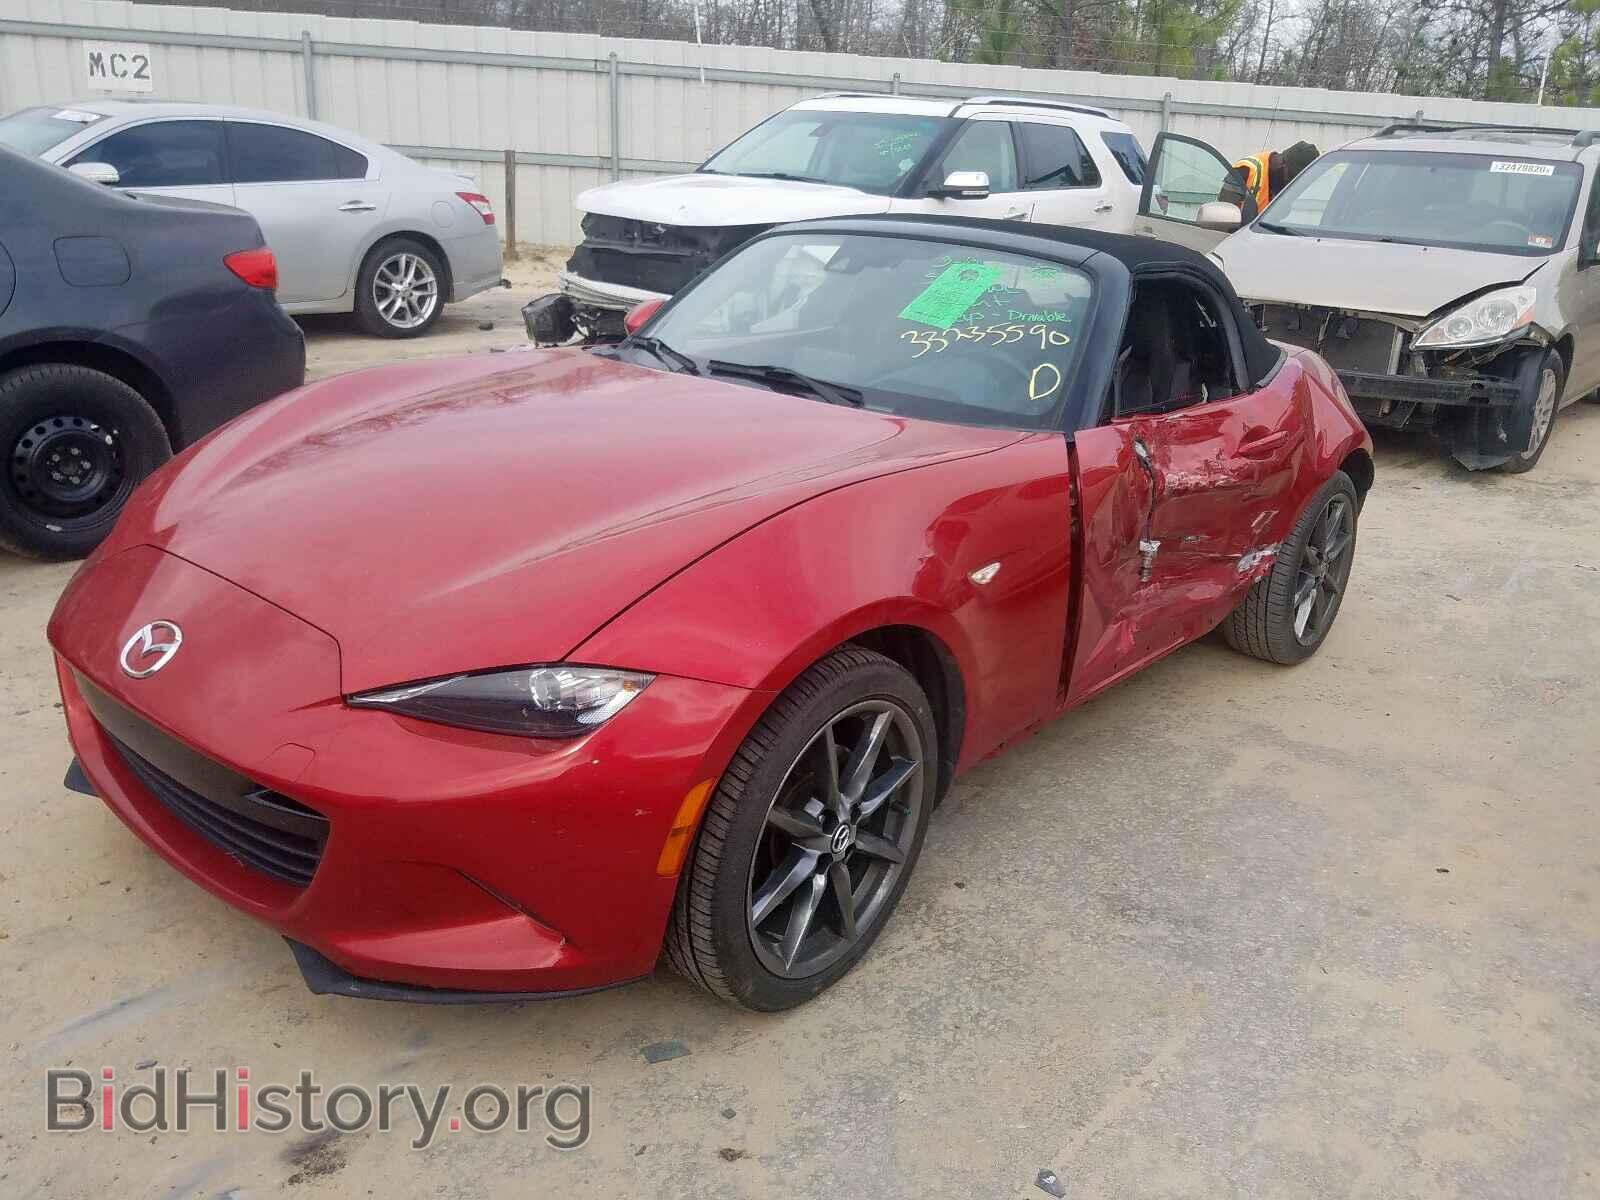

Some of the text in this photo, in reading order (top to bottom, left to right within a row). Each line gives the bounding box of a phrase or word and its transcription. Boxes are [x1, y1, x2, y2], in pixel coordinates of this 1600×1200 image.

[89, 52, 150, 80] MC2
[900, 322, 1070, 359] 33235590
[1029, 363, 1061, 401] D
